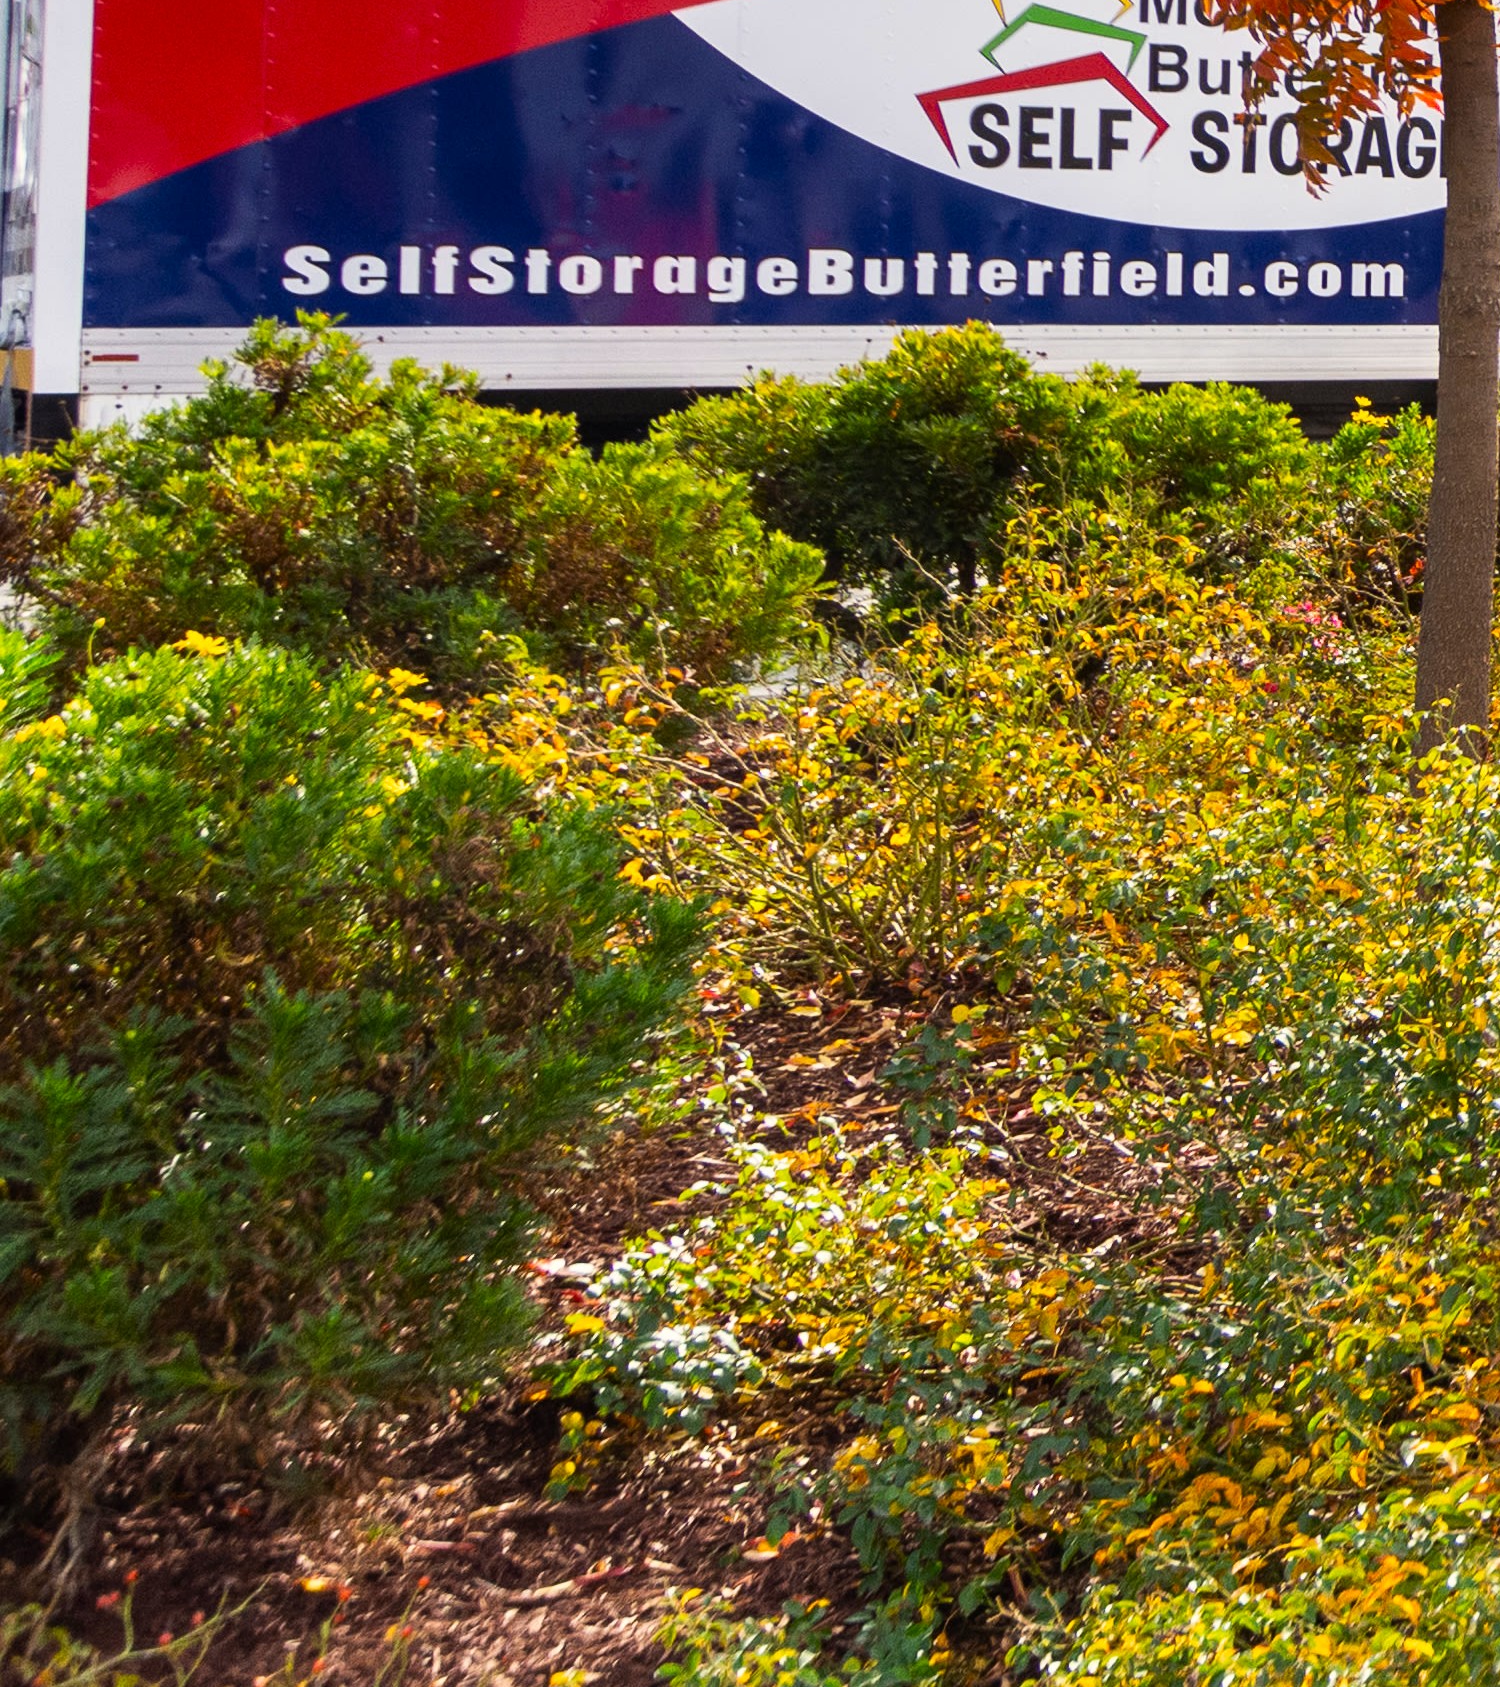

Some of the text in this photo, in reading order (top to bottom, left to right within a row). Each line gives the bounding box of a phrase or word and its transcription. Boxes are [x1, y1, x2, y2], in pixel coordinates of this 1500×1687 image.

[968, 102, 1447, 179] SELF STORAG
[283, 244, 1405, 304] SelfStorageButterfield.com
